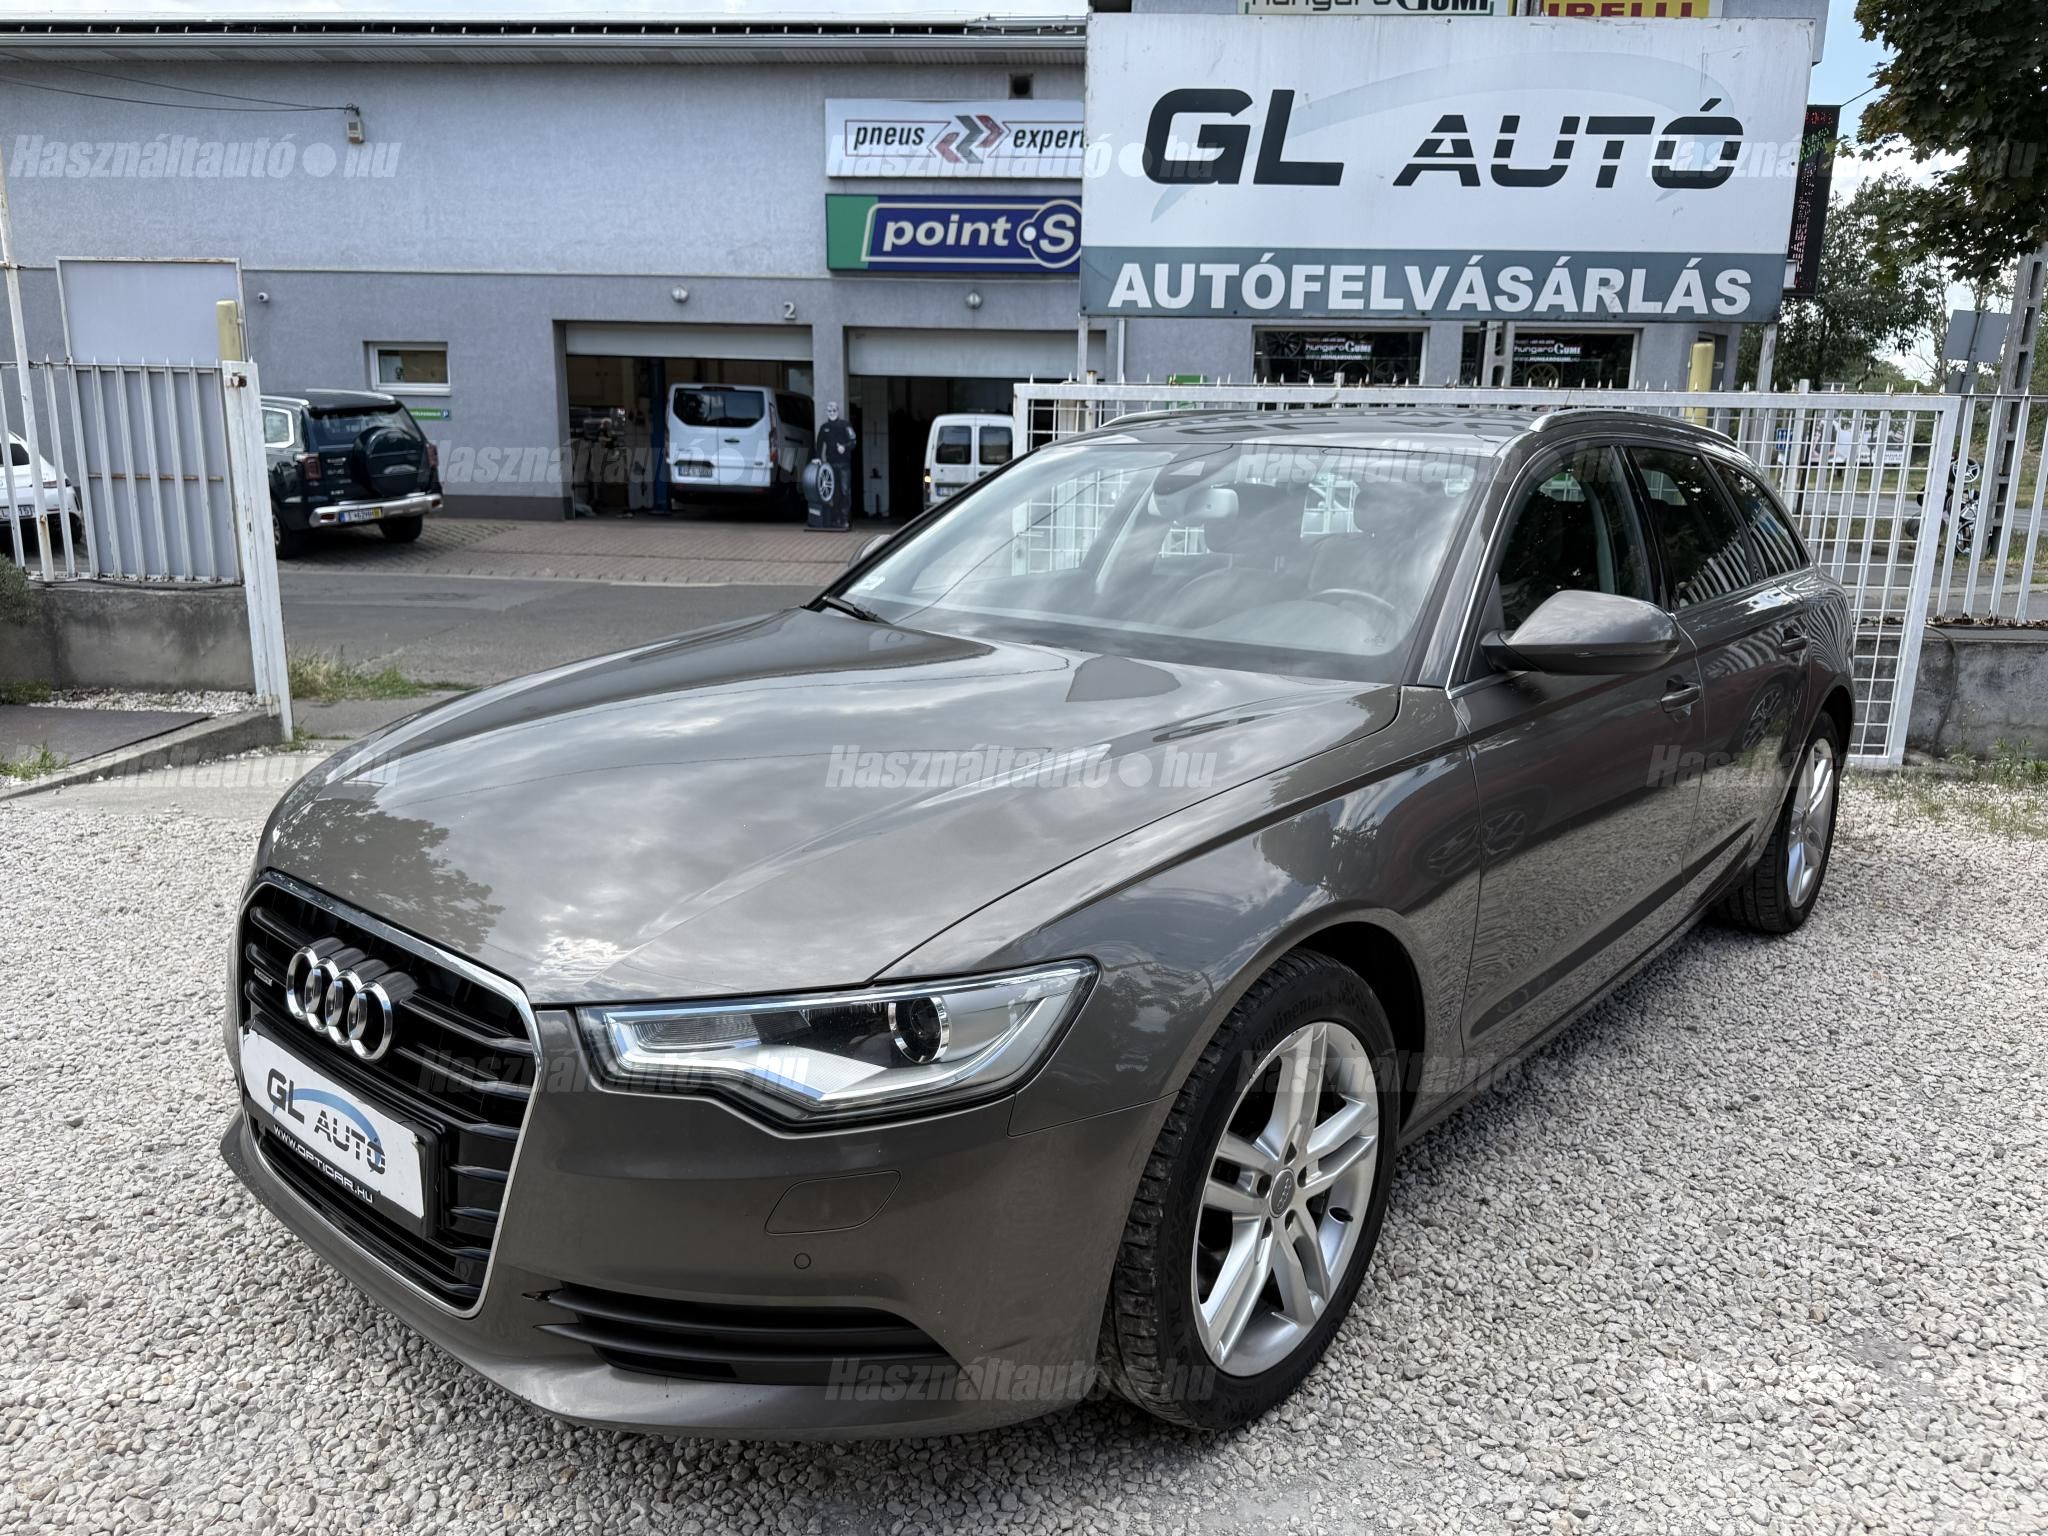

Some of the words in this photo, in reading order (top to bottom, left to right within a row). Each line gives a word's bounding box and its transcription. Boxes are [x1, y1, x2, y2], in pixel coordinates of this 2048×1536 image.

[854, 125, 925, 151] pneus
[1141, 88, 1344, 186] GL
[1393, 98, 1744, 189] AUTÓ
[882, 213, 1012, 252] point
[1039, 213, 1076, 254] S
[784, 301, 796, 319] 2
[1107, 252, 1752, 317] AUTÓFELVÁSÁRLÁS
[267, 1068, 304, 1125] GL
[314, 1109, 385, 1175] AUTÓ
[273, 1123, 373, 1204] WWW.OPTICAR.HU
